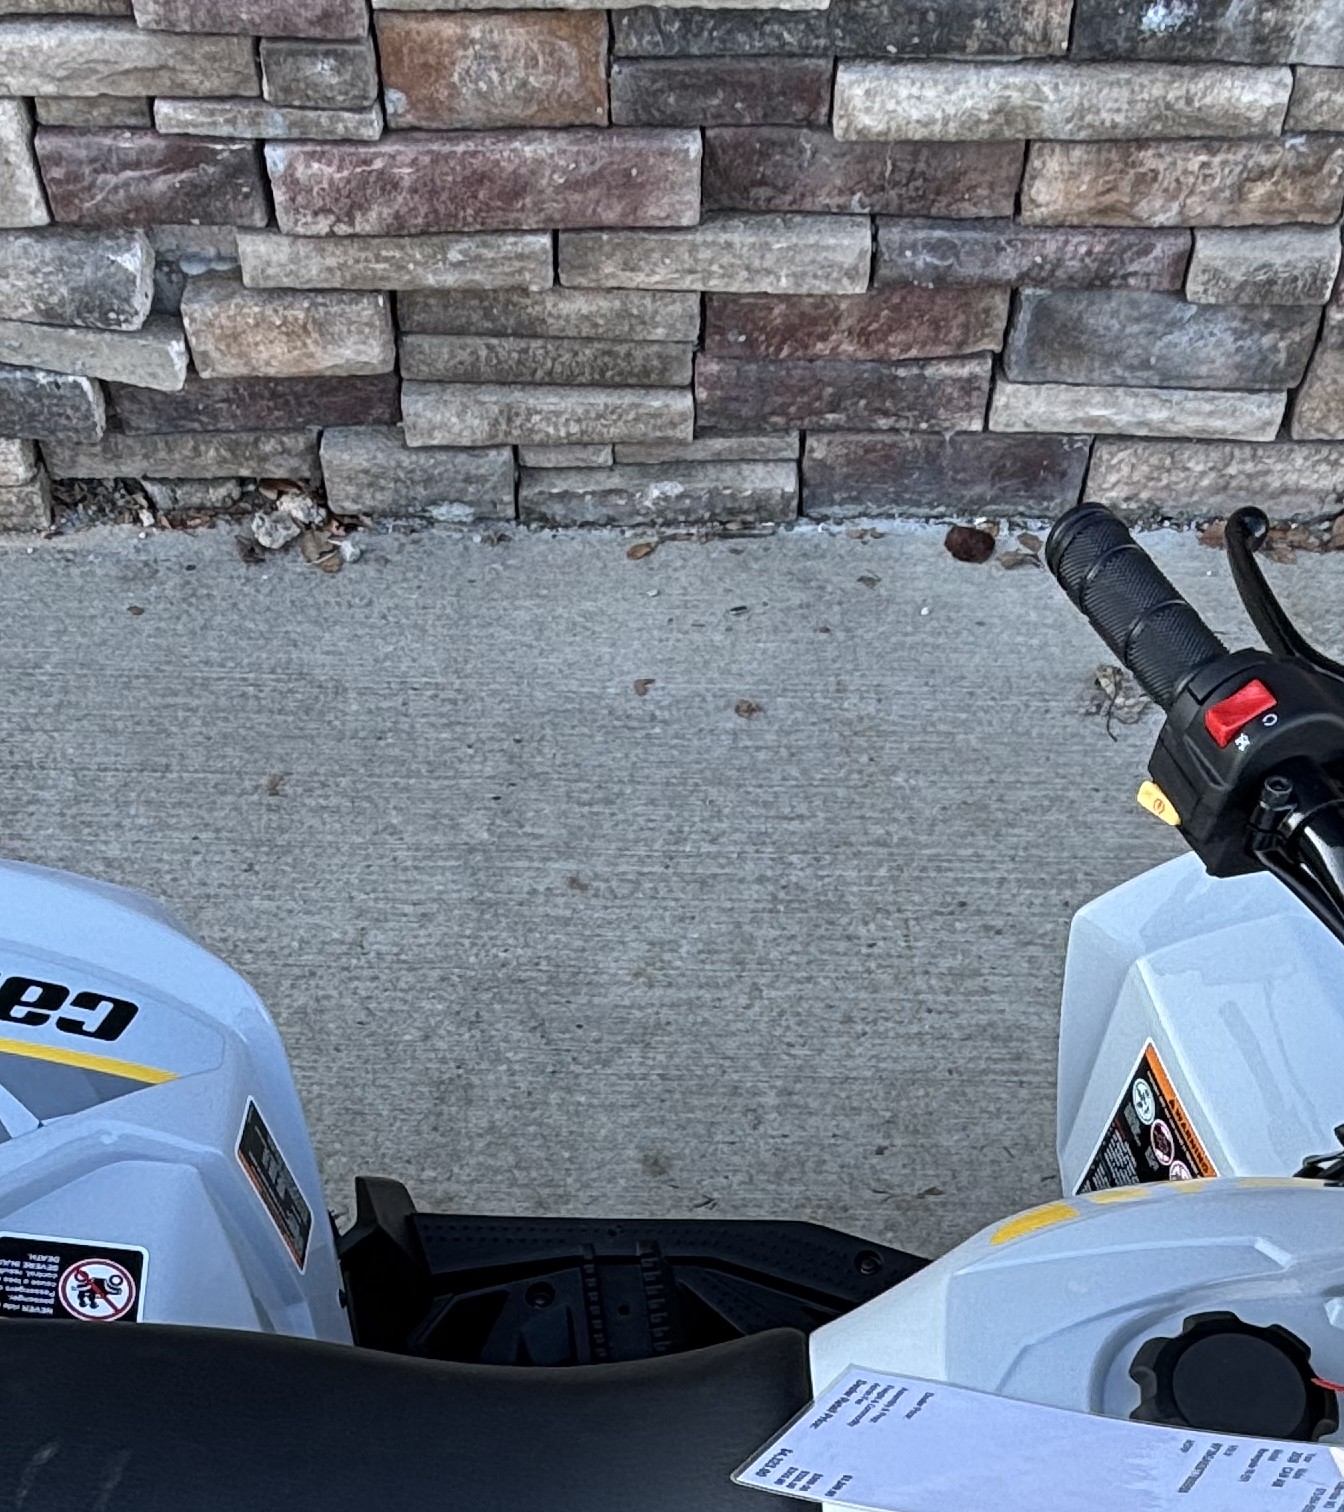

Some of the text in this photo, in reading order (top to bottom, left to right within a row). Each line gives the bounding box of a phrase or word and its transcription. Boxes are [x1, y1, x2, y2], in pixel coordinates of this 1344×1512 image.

[1174, 1107, 1209, 1173] WARNING
[23, 1262, 59, 1271] SEVERE
[22, 1305, 53, 1314] NEVER
